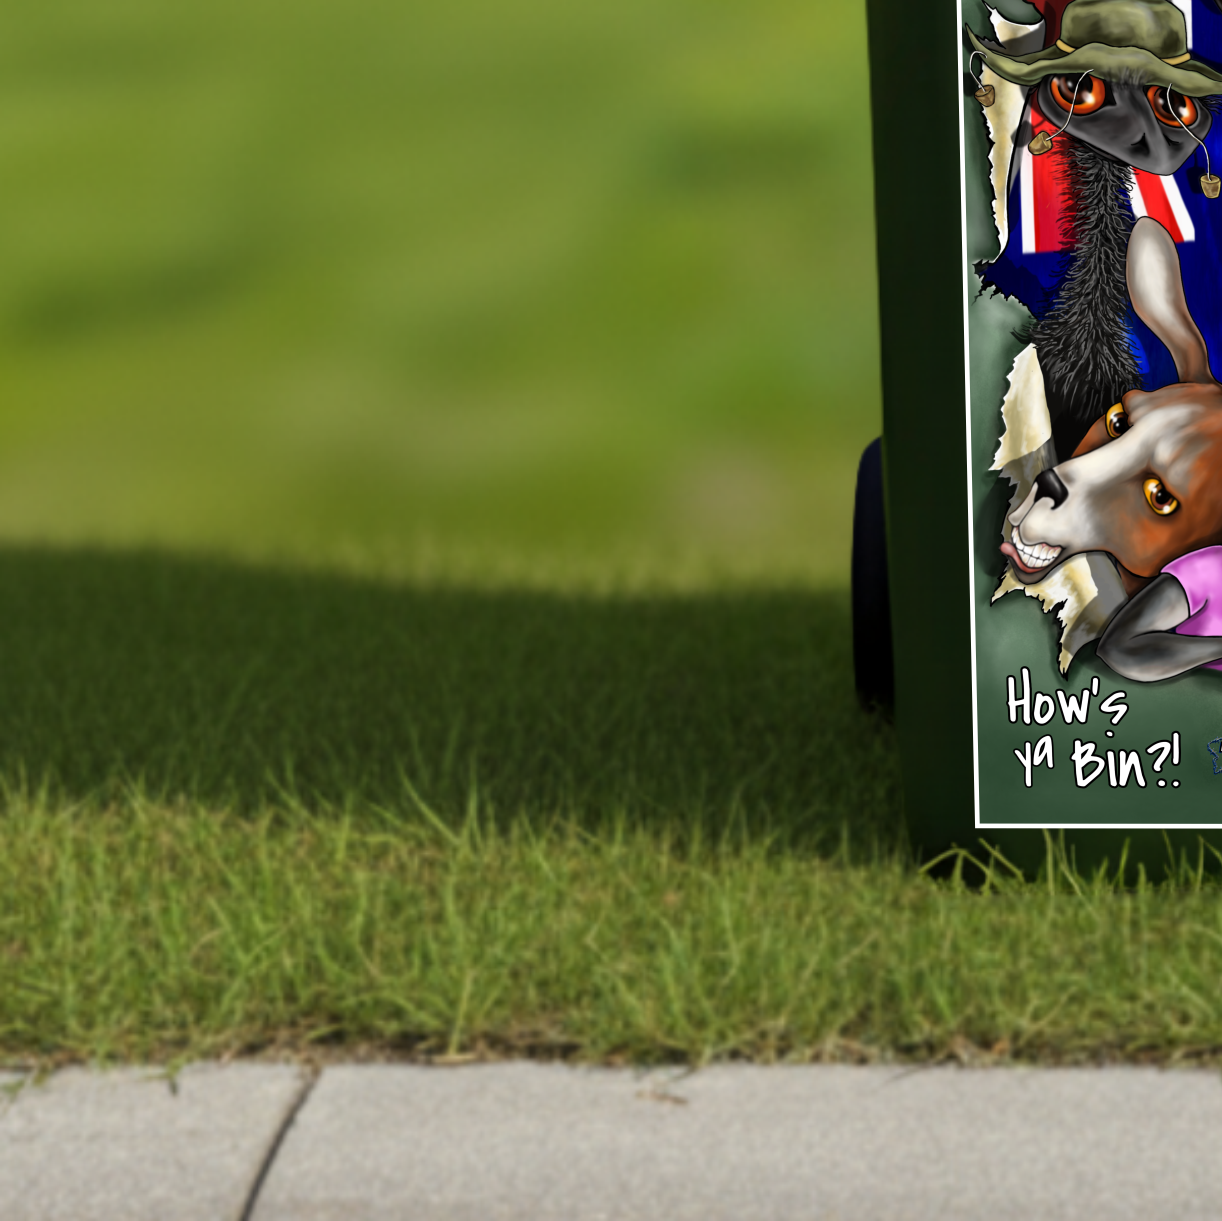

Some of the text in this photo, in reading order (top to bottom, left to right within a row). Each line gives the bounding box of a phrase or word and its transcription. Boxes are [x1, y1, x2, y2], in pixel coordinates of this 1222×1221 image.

[1006, 666, 1129, 725] How's
[1014, 730, 1181, 788] ya Bin?!
